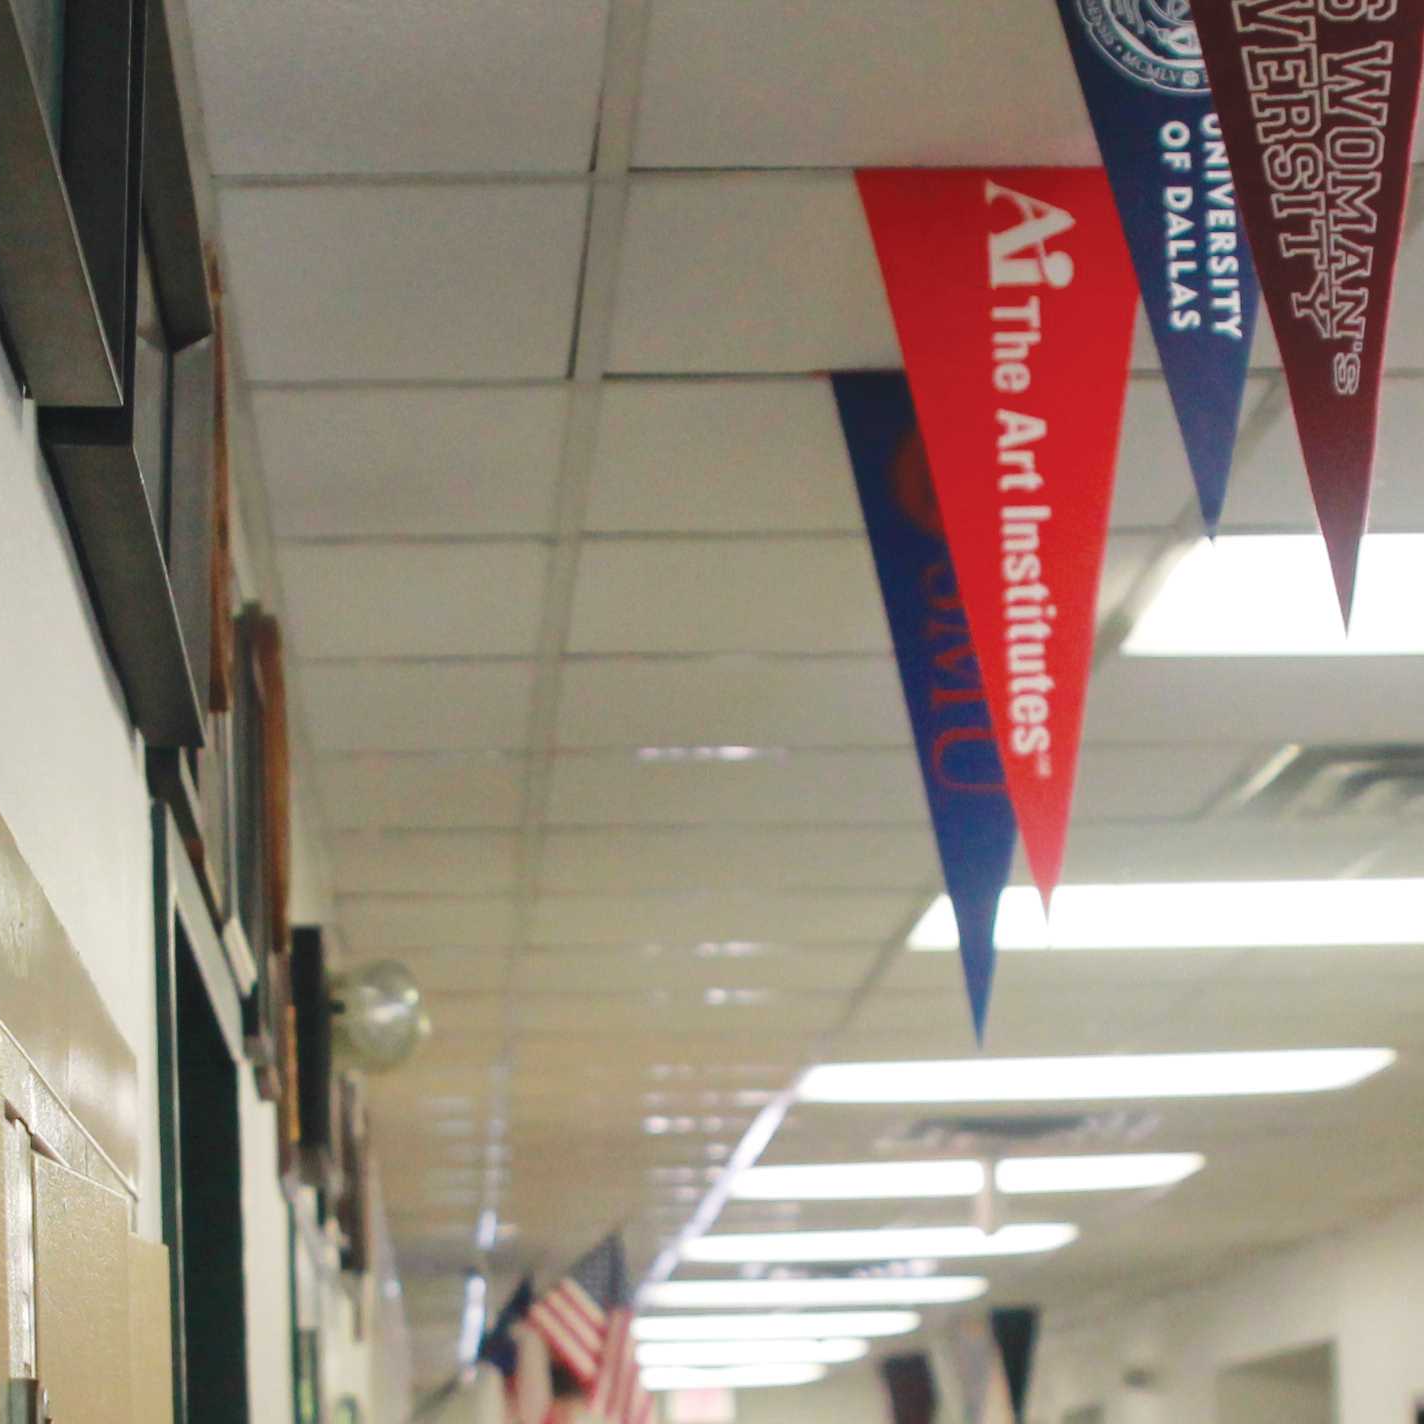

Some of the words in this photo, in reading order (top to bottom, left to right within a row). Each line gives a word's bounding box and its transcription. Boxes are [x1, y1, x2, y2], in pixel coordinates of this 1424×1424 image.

[1160, 120, 1192, 171] OF
[1163, 186, 1201, 331] DALLAS
[1199, 113, 1243, 339] UNIVERSITY
[1320, 40, 1394, 396] WOMAN'S
[990, 295, 1042, 394] The
[995, 408, 1048, 491] Art
